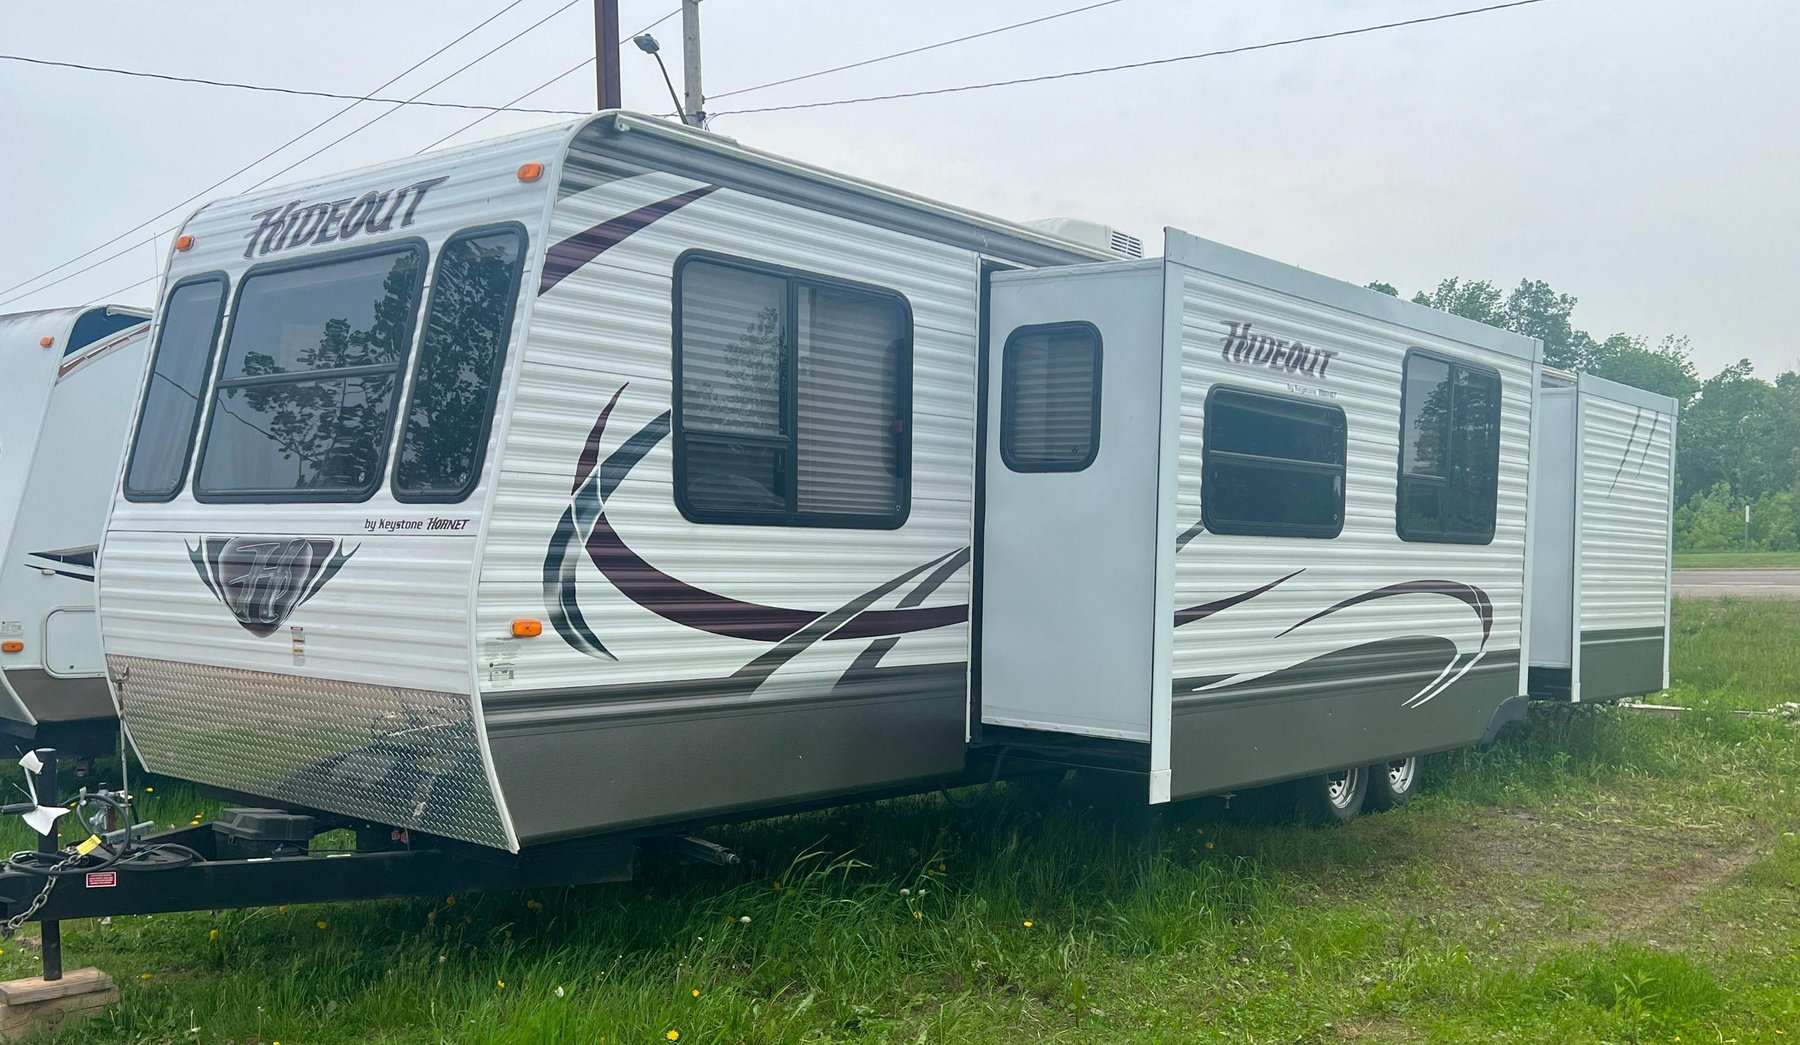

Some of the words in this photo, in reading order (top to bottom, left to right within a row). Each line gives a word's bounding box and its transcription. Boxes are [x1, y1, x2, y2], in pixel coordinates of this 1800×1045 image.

[243, 176, 450, 259] HIDEOUT
[1220, 320, 1338, 379] HIDEOUT
[365, 518, 377, 532] by
[378, 518, 423, 532] Keystone
[427, 517, 470, 530] HORNET
